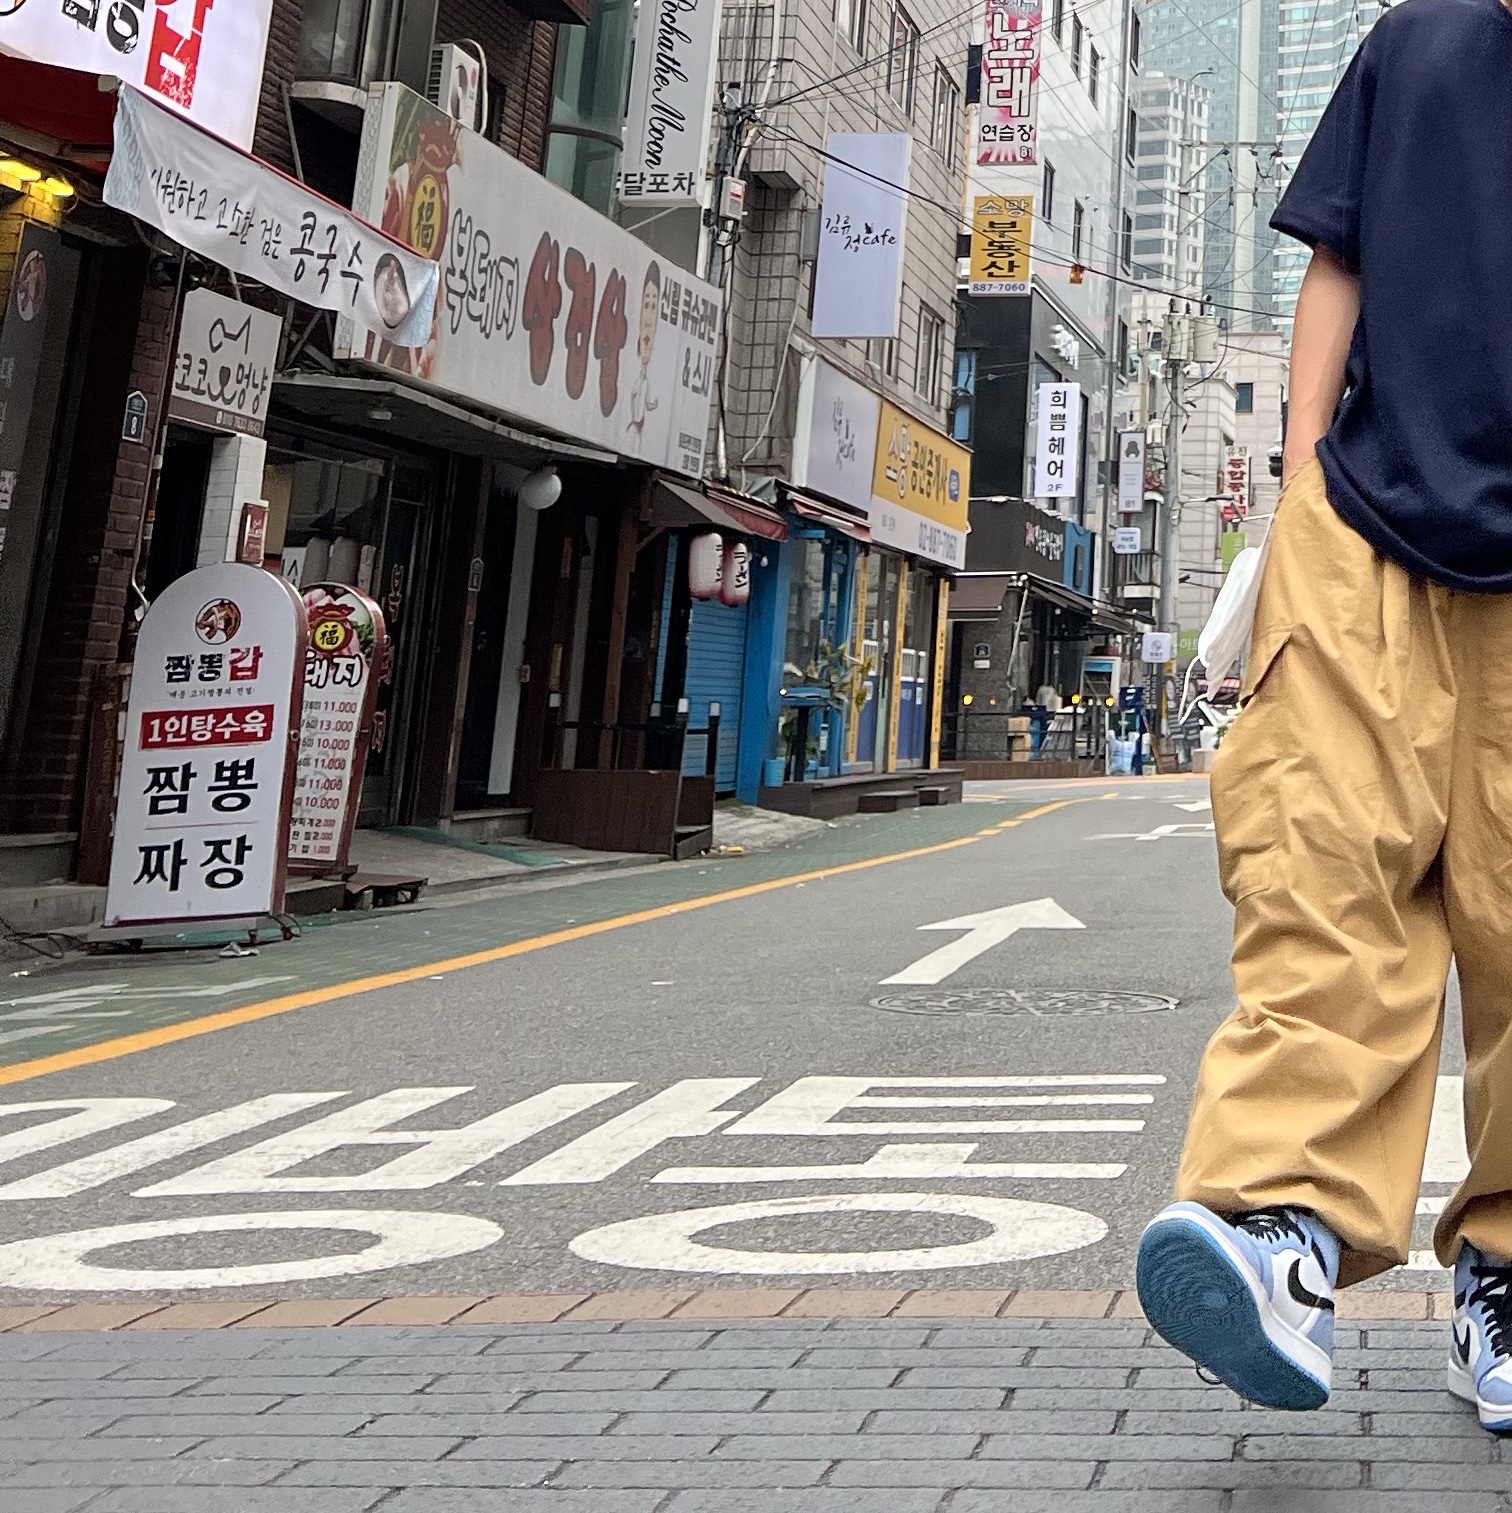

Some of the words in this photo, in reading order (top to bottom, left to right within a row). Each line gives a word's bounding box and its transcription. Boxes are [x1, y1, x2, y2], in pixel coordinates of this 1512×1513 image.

[987, 12, 1035, 118] 노래
[981, 124, 1035, 144] 연습장
[976, 198, 1030, 217] 소망
[290, 211, 363, 307] 콩국수
[863, 228, 896, 246] cafe
[980, 220, 1023, 279] 부동산
[445, 208, 519, 340] 복돼지
[522, 231, 628, 417] 삼겹살
[1047, 390, 1067, 479] 희쁨헤어
[1047, 484, 1063, 493] 2F
[321, 624, 340, 646] 福
[165, 645, 264, 684] 짬뽕갑
[148, 710, 267, 743] 1인탕수육
[143, 758, 258, 815] 짬뽕
[133, 834, 252, 891] 짜장
